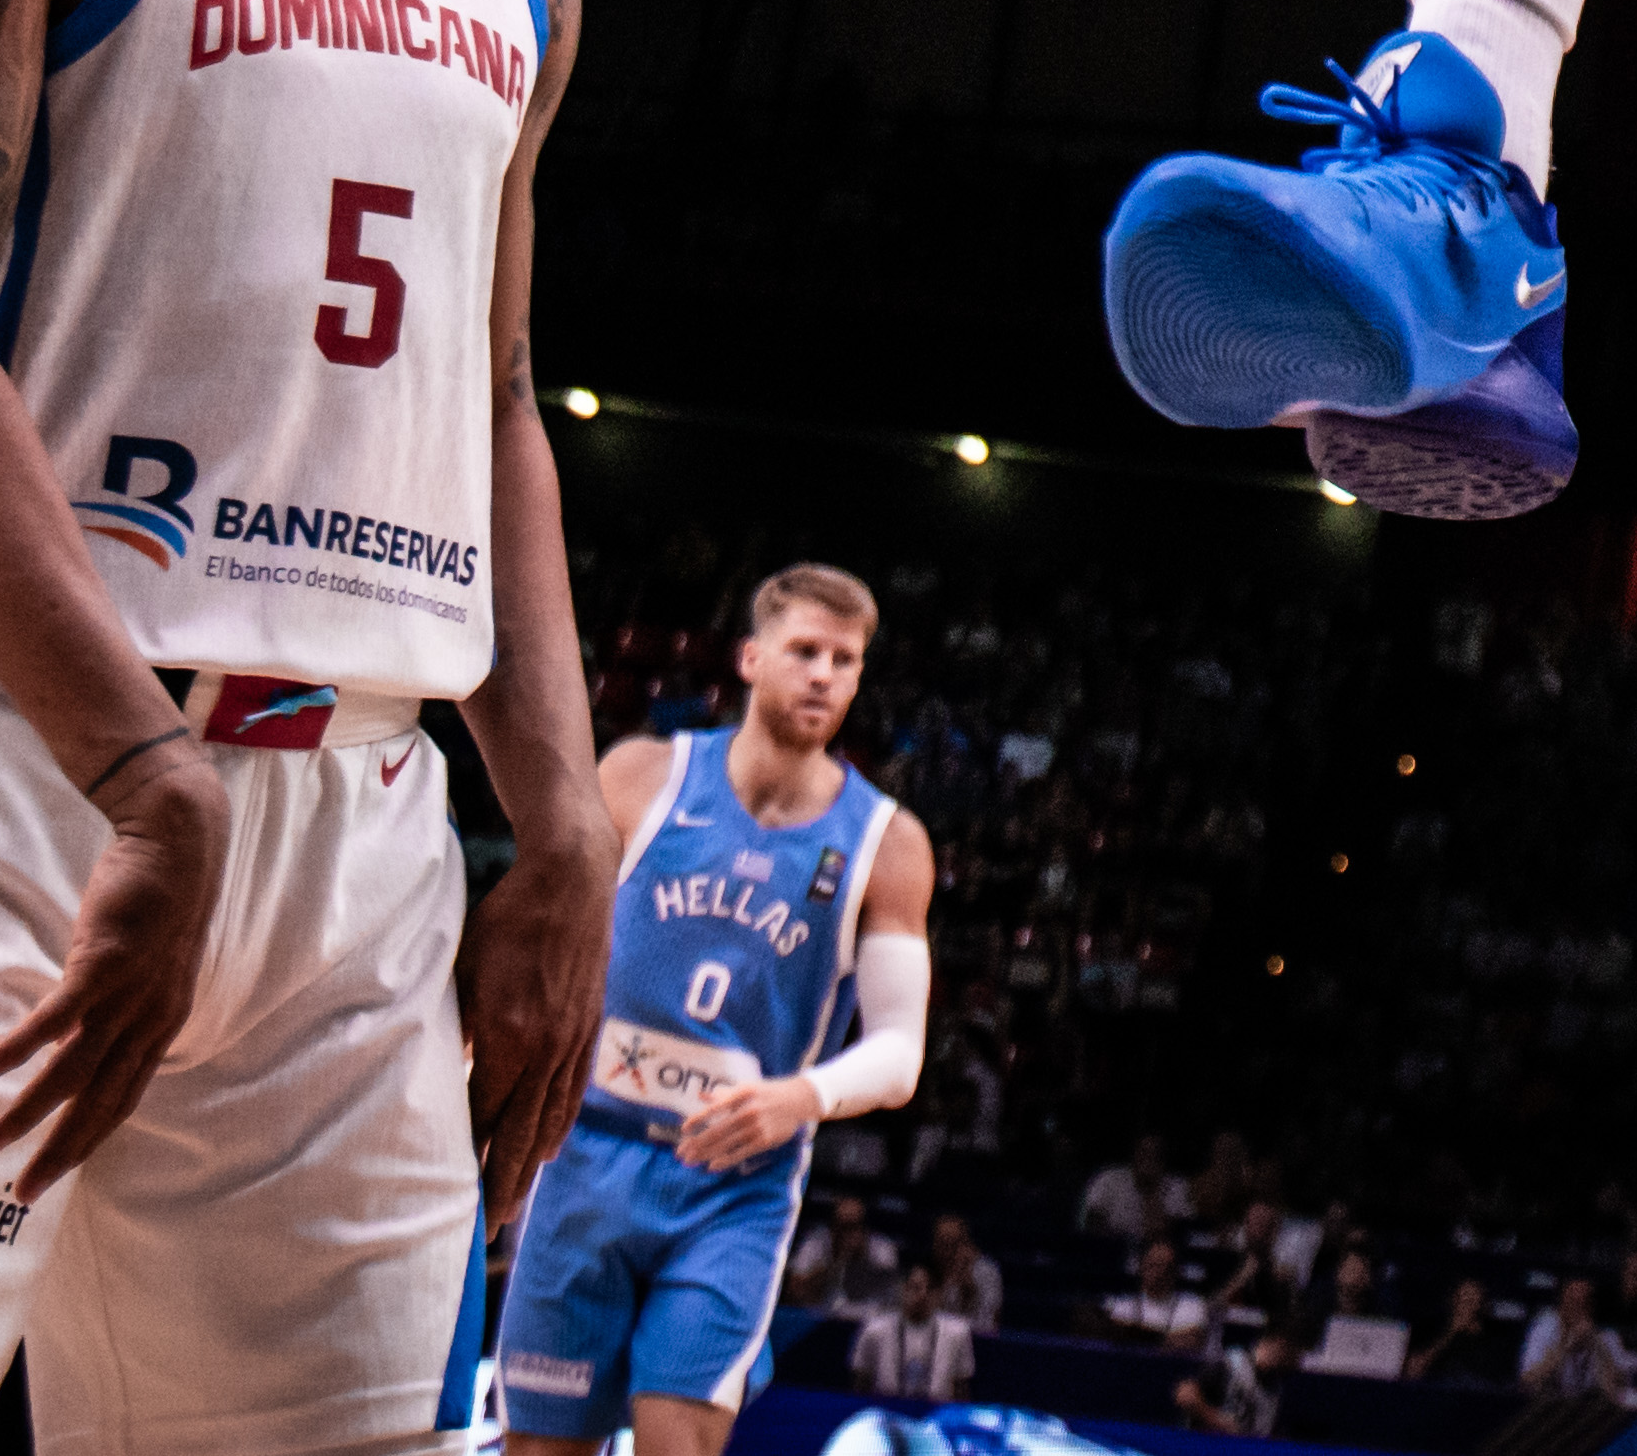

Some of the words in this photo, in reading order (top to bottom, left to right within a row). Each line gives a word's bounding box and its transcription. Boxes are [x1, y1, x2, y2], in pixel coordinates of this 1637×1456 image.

[313, 177, 416, 370] 5
[212, 497, 480, 587] BANRESERVAS
[204, 555, 227, 578] El
[229, 556, 301, 585] banco
[305, 566, 329, 589] de
[327, 571, 375, 600] todos
[375, 578, 396, 605] los
[397, 589, 469, 625] dominicanos
[653, 873, 811, 957] HELLAS
[684, 959, 732, 1023] 0
